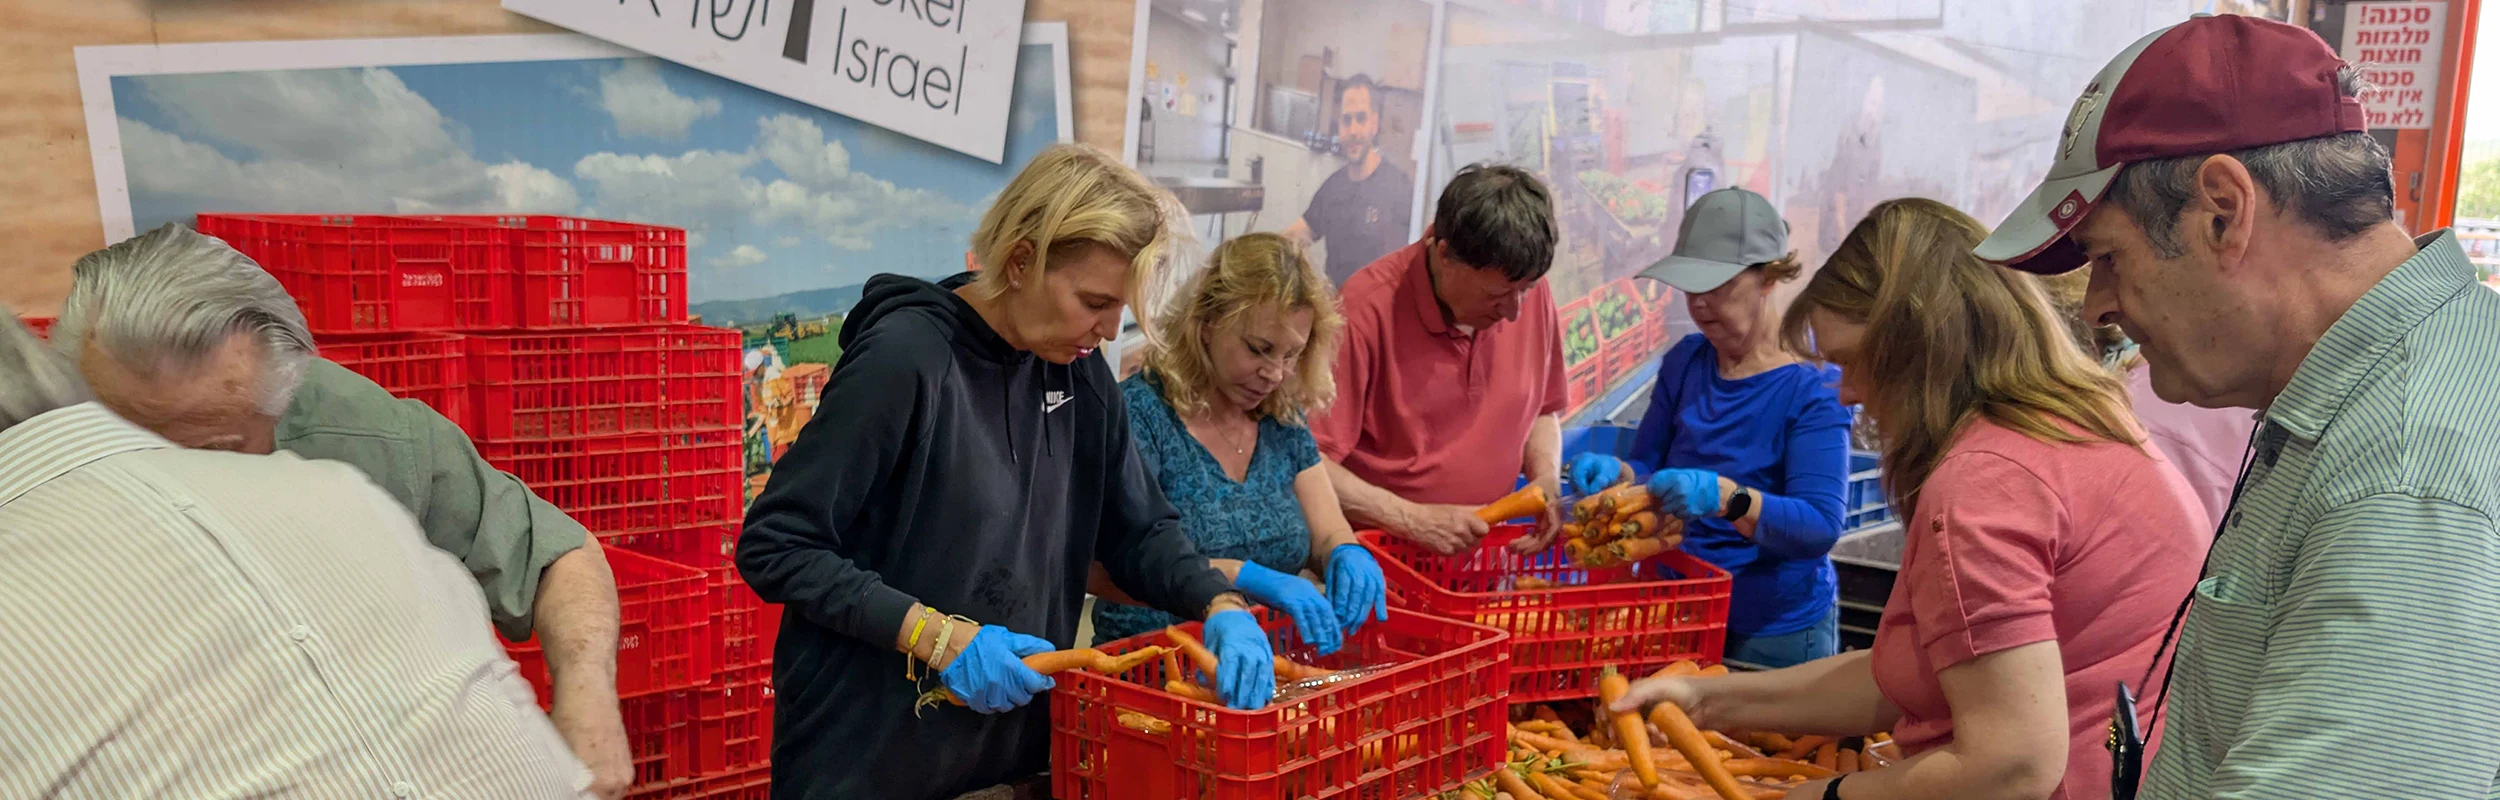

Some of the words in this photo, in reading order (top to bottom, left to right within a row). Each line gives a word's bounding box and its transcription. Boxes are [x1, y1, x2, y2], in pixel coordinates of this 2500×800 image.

[871, 0, 966, 34] et
[2360, 6, 2431, 24] סכנה!
[2356, 26, 2431, 45] מלגזות
[833, 7, 967, 115] Israel
[2360, 49, 2422, 63] חוצות
[2360, 89, 2394, 103] יציא
[2397, 90, 2423, 107] אין
[2391, 108, 2424, 125] ללא
